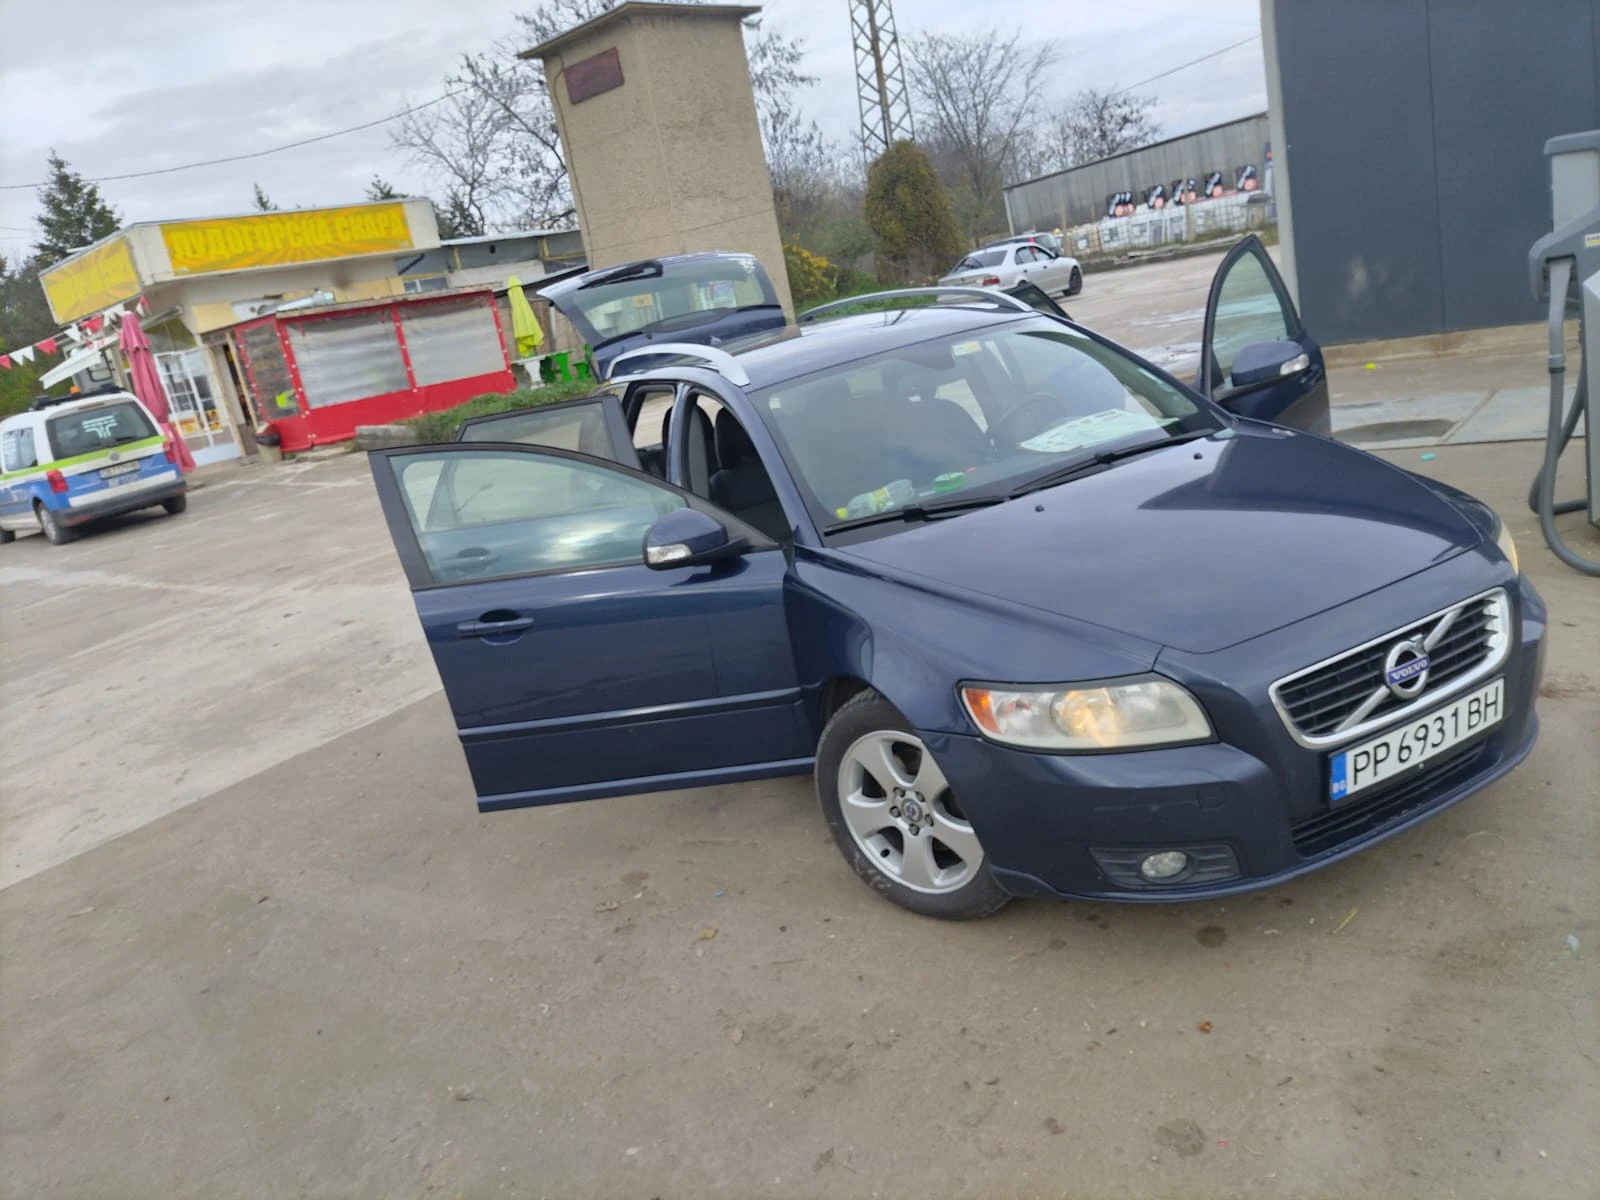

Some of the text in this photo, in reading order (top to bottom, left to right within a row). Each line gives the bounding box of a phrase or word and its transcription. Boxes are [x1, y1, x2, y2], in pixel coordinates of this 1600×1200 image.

[334, 210, 405, 243] СКАРА
[1391, 659, 1428, 680] VOLVO
[1397, 708, 1459, 763] 6931
[1332, 779, 1347, 794] BG
